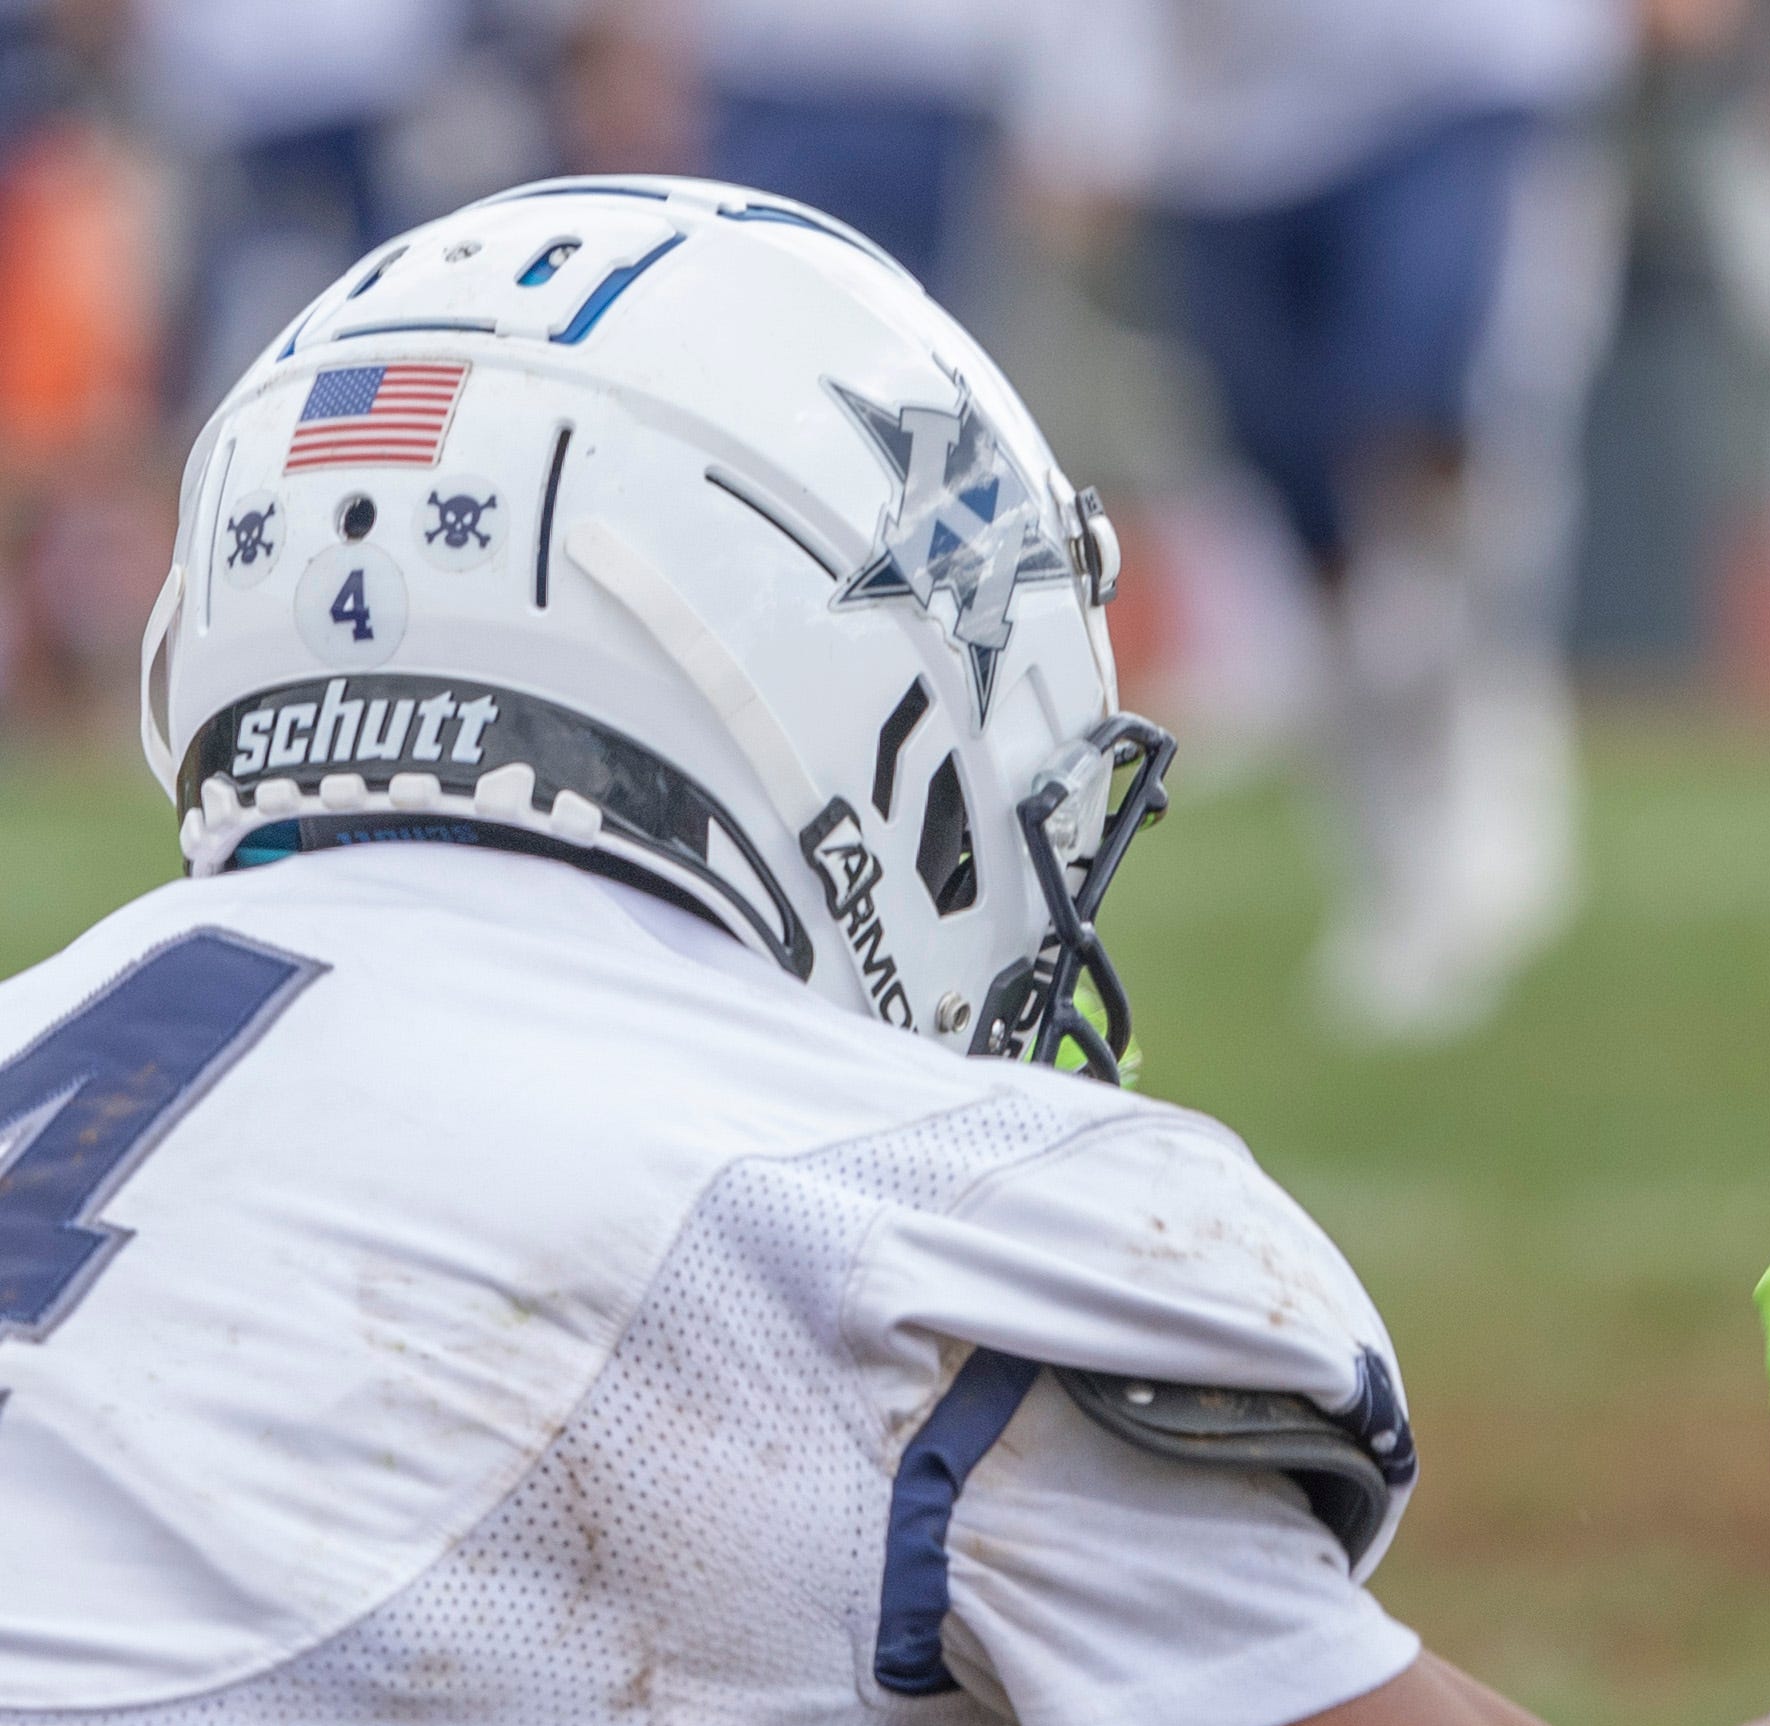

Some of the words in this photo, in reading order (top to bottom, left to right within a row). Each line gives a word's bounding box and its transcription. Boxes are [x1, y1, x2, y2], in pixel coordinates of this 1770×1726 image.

[329, 568, 375, 643] 4
[232, 678, 499, 778] schutt
[802, 797, 919, 1037] ARMO
